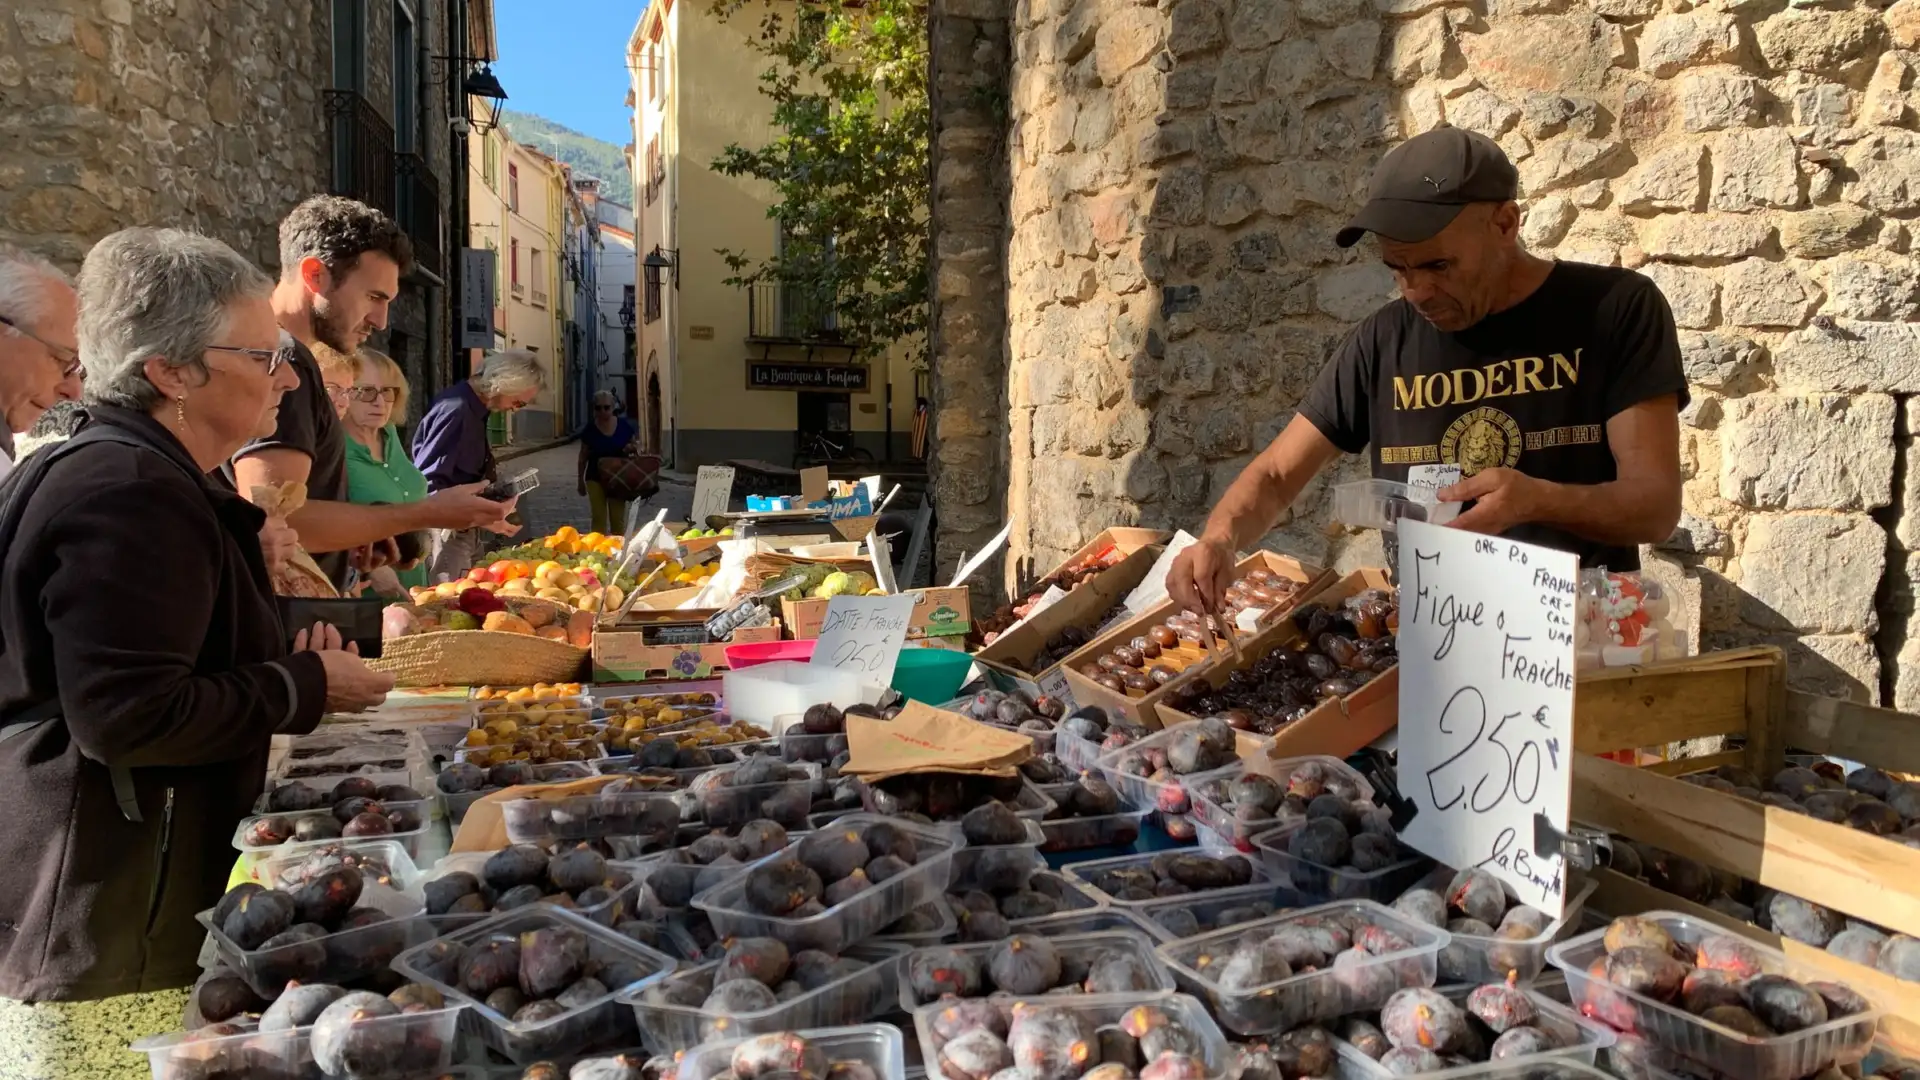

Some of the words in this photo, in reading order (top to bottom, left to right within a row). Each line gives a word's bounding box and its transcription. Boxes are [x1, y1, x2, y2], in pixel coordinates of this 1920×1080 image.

[756, 367, 768, 383] La
[771, 368, 813, 384] Boutique
[826, 368, 862, 388] Fonfon
[1392, 347, 1583, 411] MODERN
[1413, 548, 1484, 660] Figue
[1532, 704, 1551, 729] €
